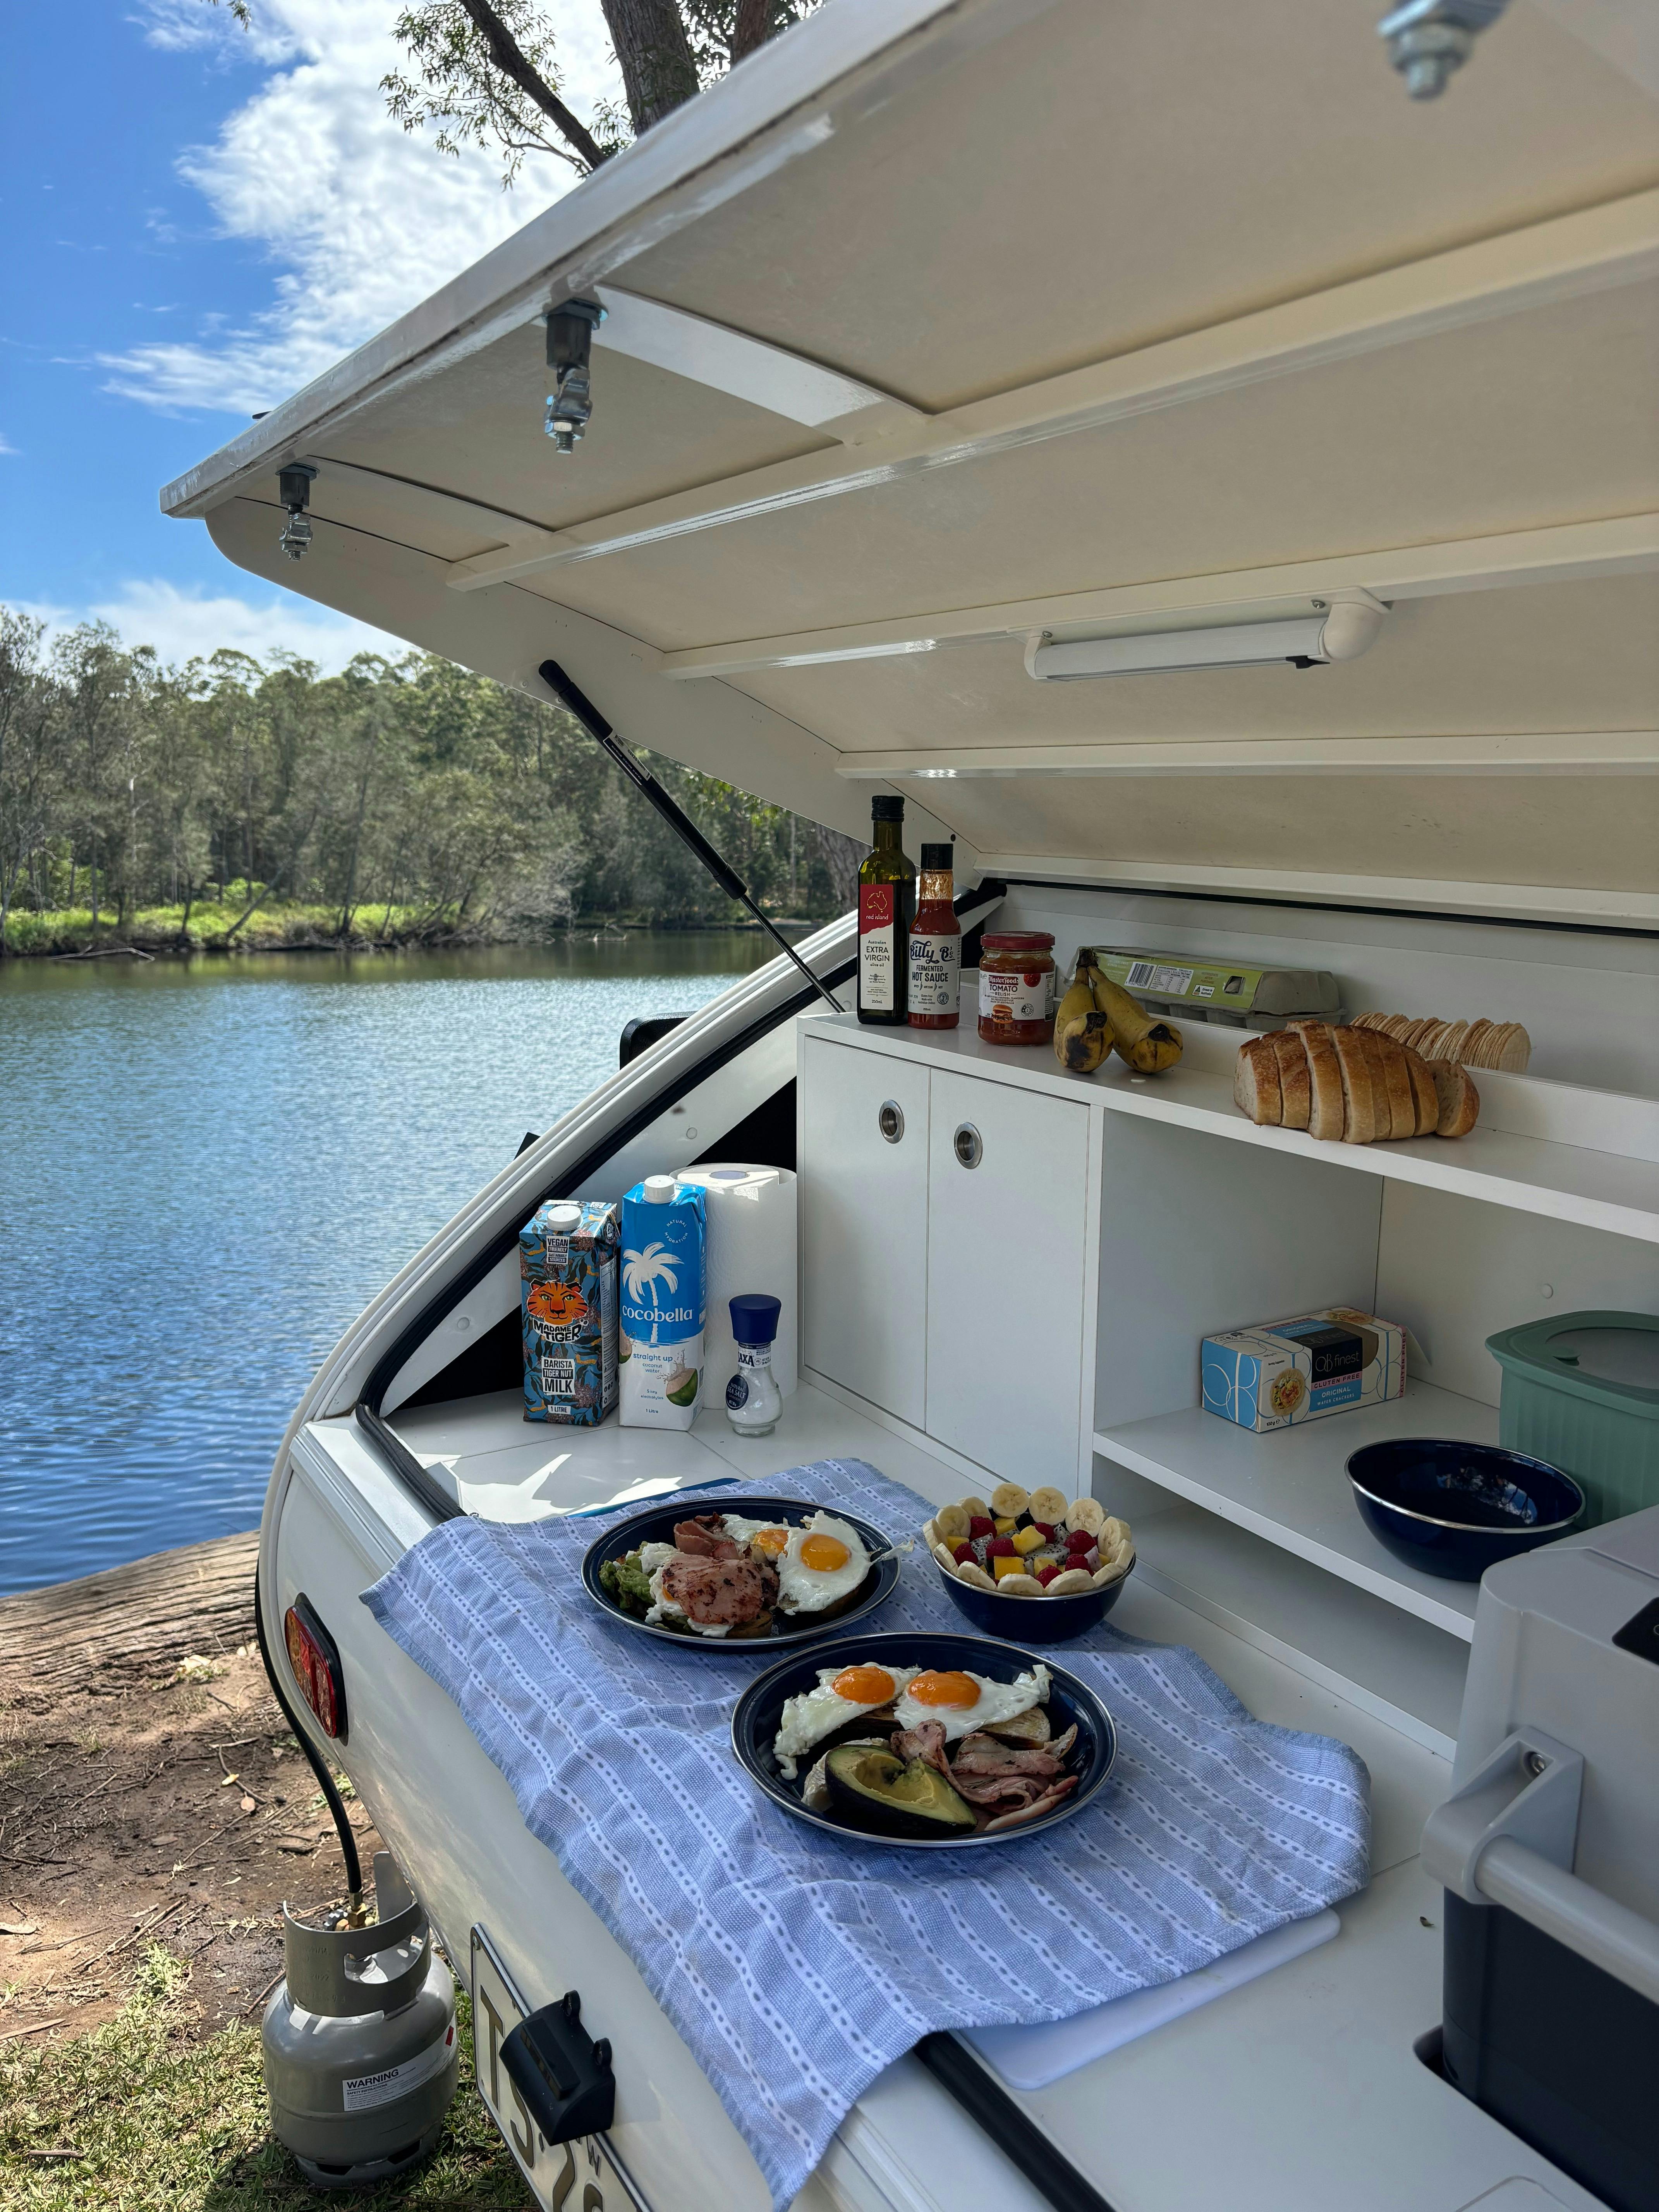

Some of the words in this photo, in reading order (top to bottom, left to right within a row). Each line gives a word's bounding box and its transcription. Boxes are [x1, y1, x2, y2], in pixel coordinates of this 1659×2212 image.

[910, 940, 940, 964] Billy
[912, 972, 923, 981] HOT
[925, 972, 948, 982] SAUCE
[989, 975, 1019, 984] MasterFoods
[548, 1238, 568, 1246] VEGAN
[665, 1232, 688, 1243] HYDRATION
[623, 1305, 692, 1322] cocobella
[534, 1319, 571, 1334] MADAME
[544, 1359, 572, 1368] BARISTA
[738, 1351, 755, 1367] AXA
[1334, 1350, 1360, 1366] finest
[545, 1379, 572, 1393] MILK
[1314, 1378, 1340, 1388] GLUTEN
[1343, 1373, 1360, 1381] FREE
[731, 1382, 744, 1392] NATURAL
[1322, 1386, 1351, 1397] ORIGINAL
[734, 1389, 746, 1399] SALT
[1333, 1393, 1354, 1402] CRACKERS
[347, 2069, 398, 2088] WARNING
